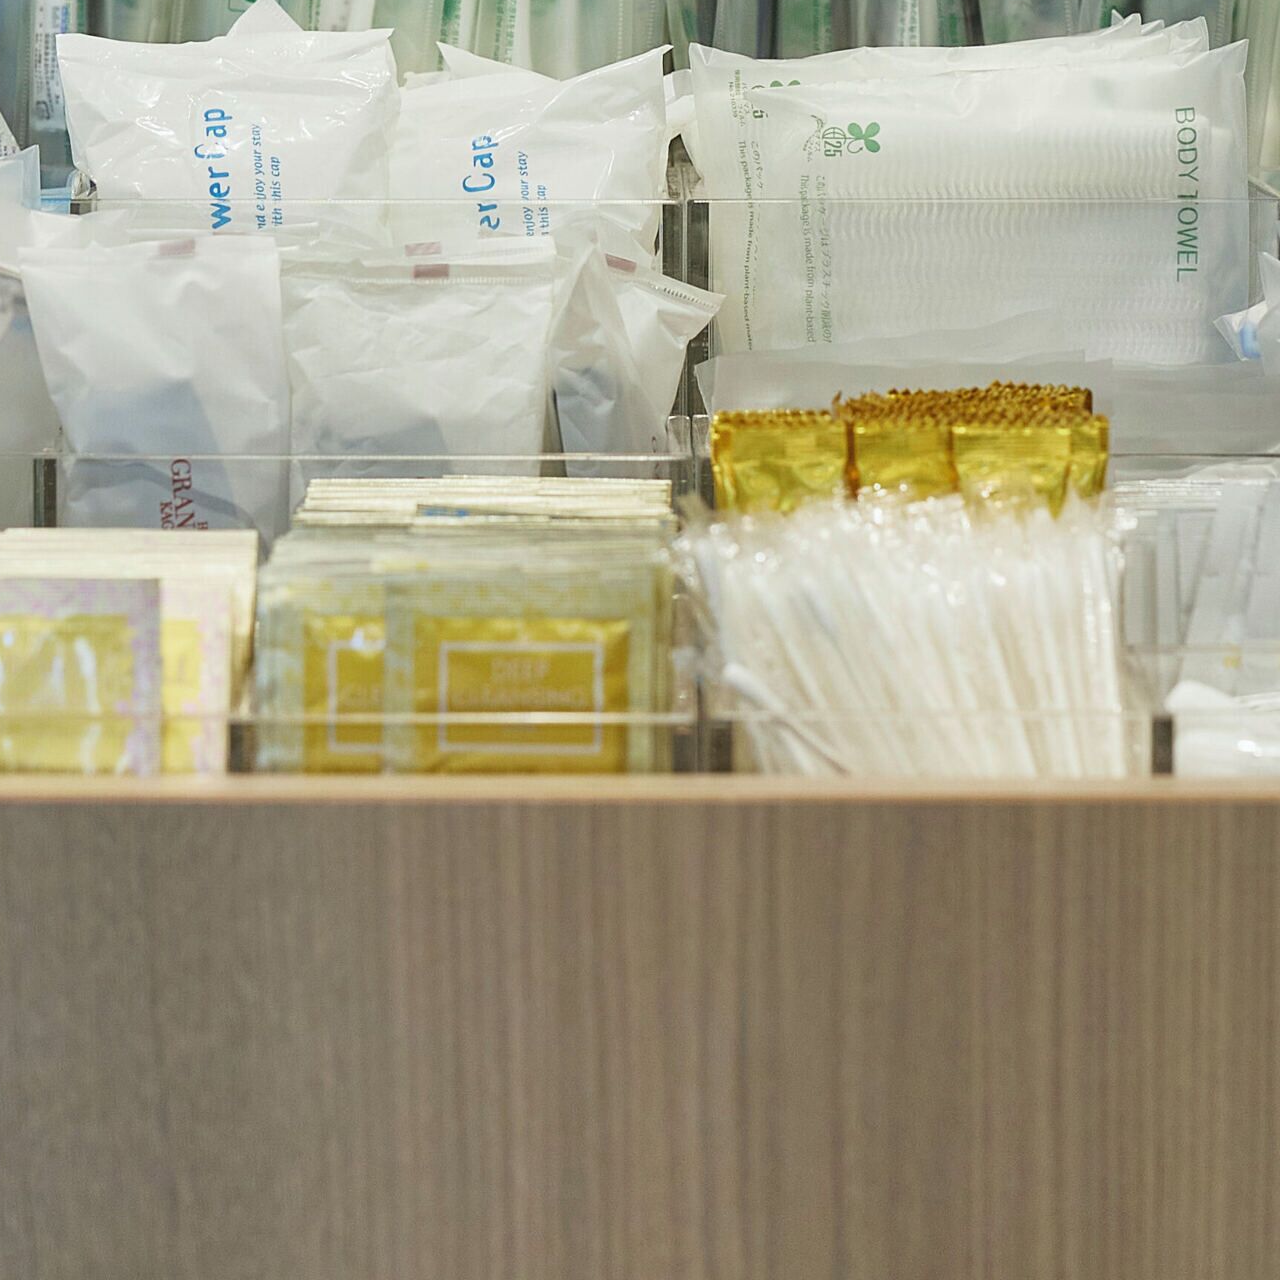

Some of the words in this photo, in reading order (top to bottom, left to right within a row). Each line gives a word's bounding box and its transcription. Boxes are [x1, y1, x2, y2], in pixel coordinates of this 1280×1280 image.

[250, 124, 265, 147] stay
[738, 140, 748, 160] This
[824, 140, 843, 157] 25
[1175, 106, 1197, 184] BODY
[254, 149, 267, 176] your
[269, 156, 281, 178] cap
[461, 135, 499, 194] Cap
[515, 151, 528, 177] stay
[740, 160, 753, 199] package
[521, 207, 536, 237] enjoy
[537, 207, 550, 229] this
[799, 190, 811, 227] package
[744, 239, 754, 263] from
[804, 237, 815, 266] made
[1176, 193, 1199, 282] TOWEL
[806, 266, 816, 288] from
[743, 264, 752, 322] plant-based
[806, 289, 817, 343] plant-based
[171, 458, 195, 528] GRAN
